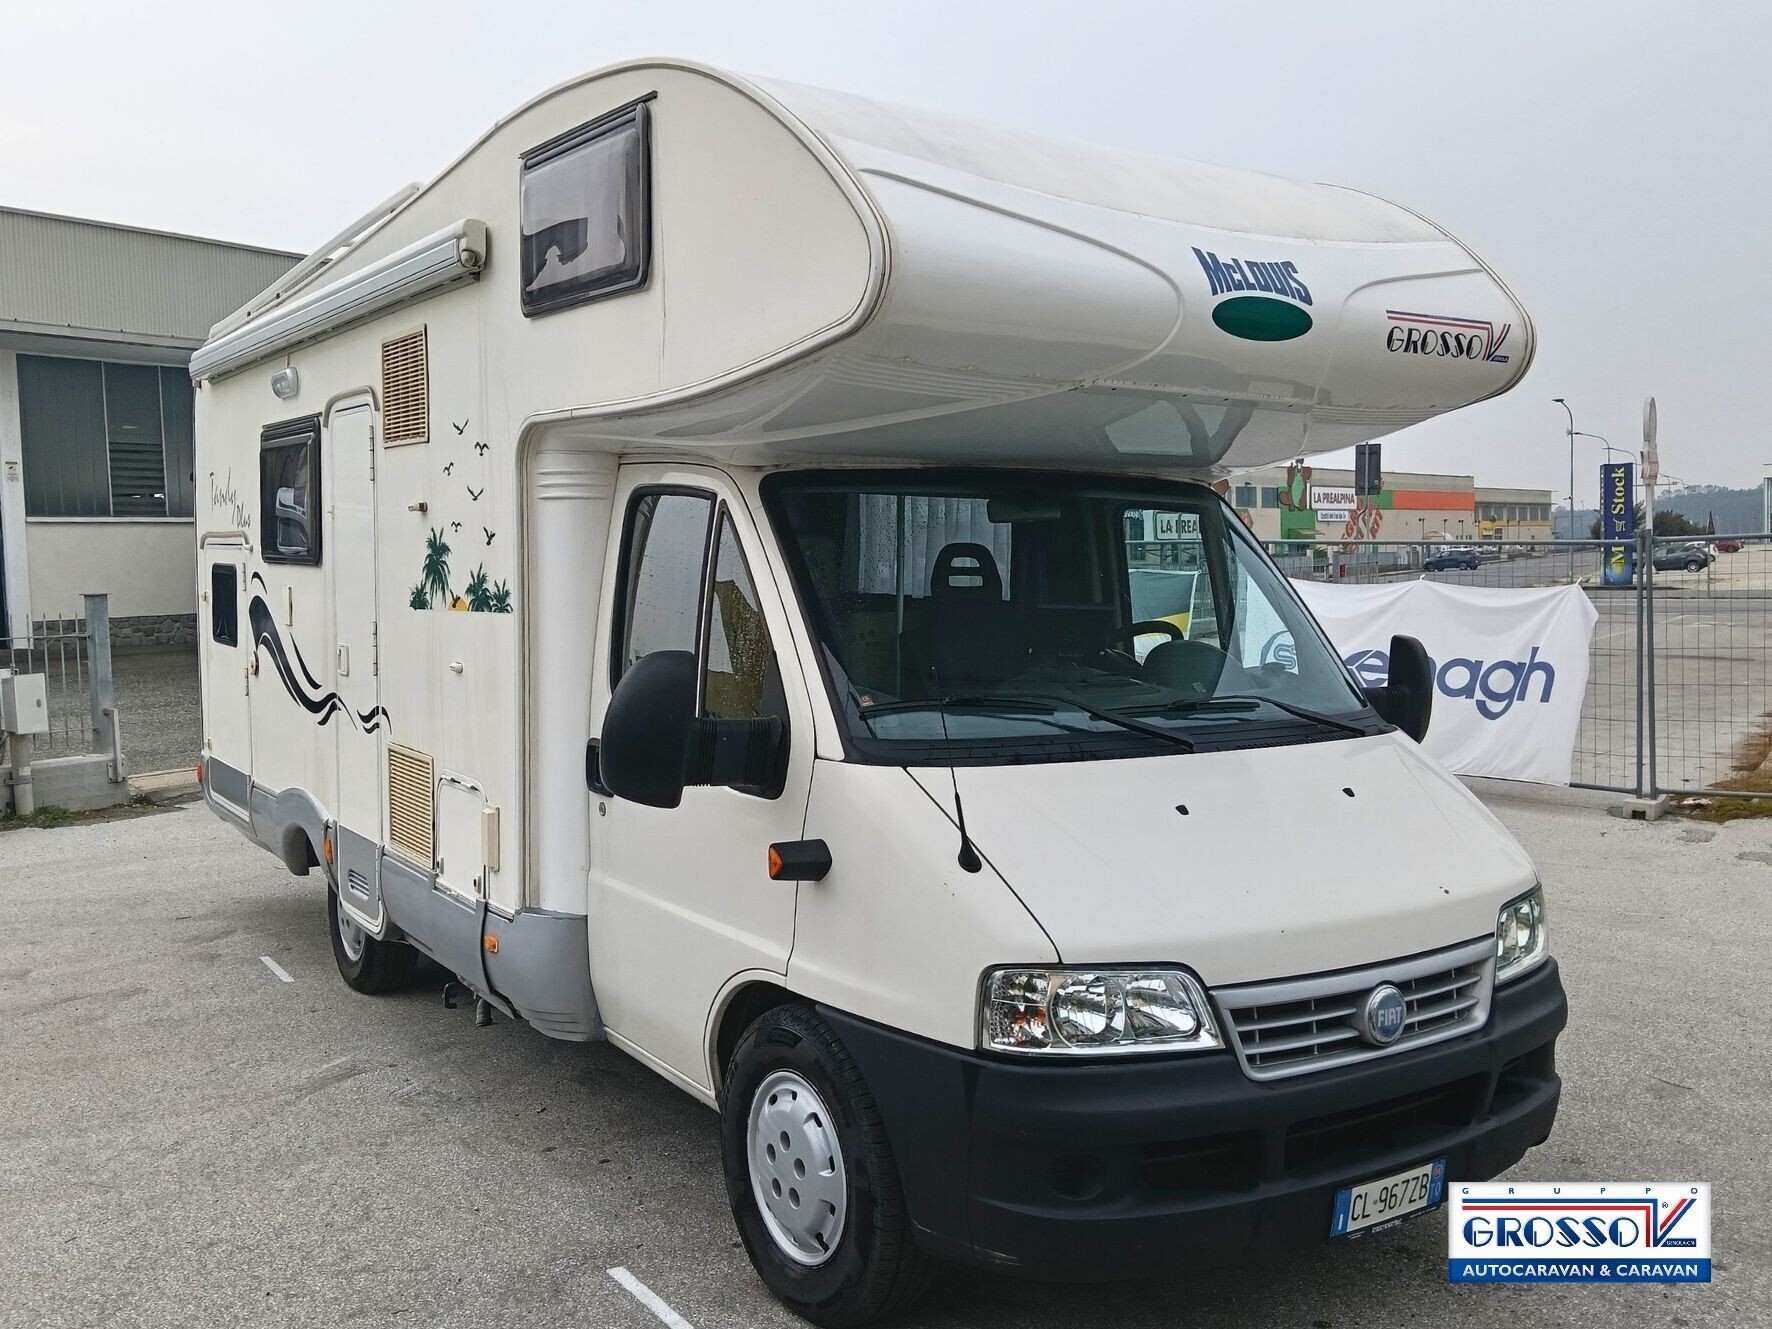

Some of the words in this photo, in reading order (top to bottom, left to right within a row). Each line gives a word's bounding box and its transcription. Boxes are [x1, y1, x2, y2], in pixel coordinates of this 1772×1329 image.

[1386, 326, 1483, 360] GROSSO
[1313, 492, 1322, 504] LA
[1322, 492, 1355, 504] PREALPINA
[1611, 467, 1625, 515] Stock
[1160, 519, 1173, 534] LA
[1377, 1006, 1402, 1028] FIAT
